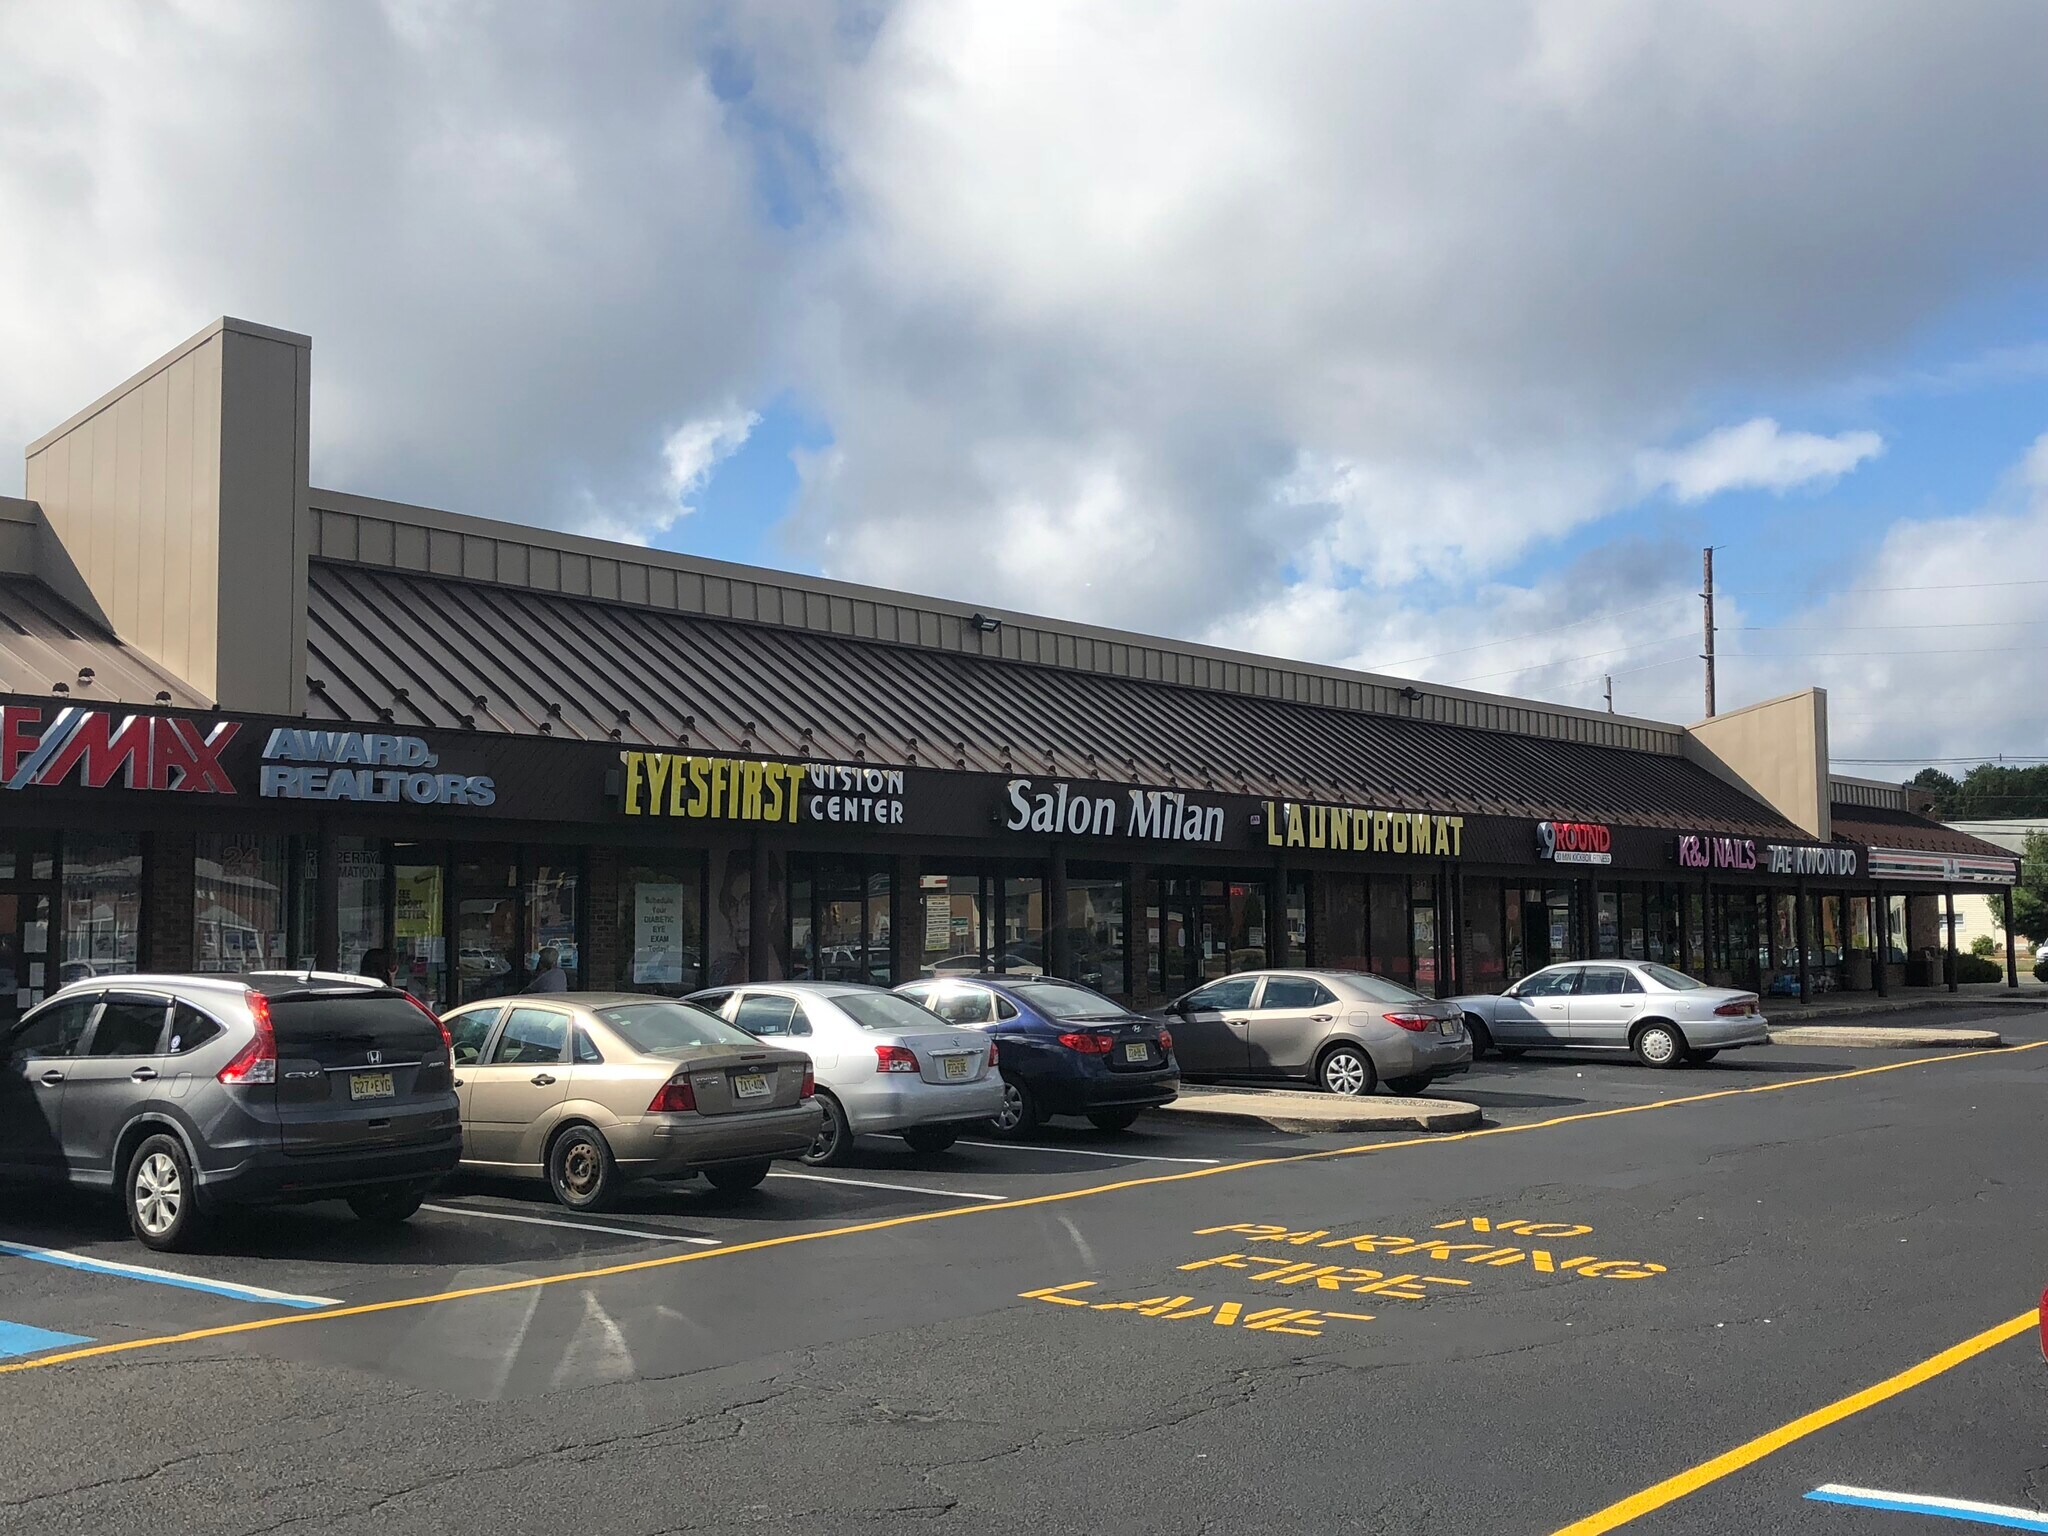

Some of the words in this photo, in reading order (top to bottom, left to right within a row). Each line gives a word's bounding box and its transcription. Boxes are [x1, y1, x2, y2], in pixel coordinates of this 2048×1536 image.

[259, 765, 497, 807] REALTORS
[620, 751, 806, 824] EYESFIRST
[807, 763, 904, 794] VISION
[810, 797, 904, 824] CENTER
[1006, 779, 1117, 836] Salon
[1127, 789, 1226, 842] Milan
[1262, 801, 1465, 857] LAUNDROMAT
[223, 846, 262, 864] 24
[1678, 835, 1710, 868] K&J
[1712, 837, 1757, 870] NAILS
[1766, 845, 1793, 874] TAE
[1793, 847, 1836, 875] KWON
[1838, 849, 1858, 876] DO
[398, 889, 411, 899] SEE
[398, 900, 423, 910] SPORT
[644, 895, 674, 904] Schedule
[1230, 887, 1244, 896] PEN
[652, 906, 667, 914] Your
[650, 935, 669, 943] EXAM
[1430, 1217, 1594, 1237] NO
[1191, 1222, 1668, 1280] PARKING
[1175, 1253, 1473, 1299] FIRE
[1017, 1280, 1378, 1336] LANE
